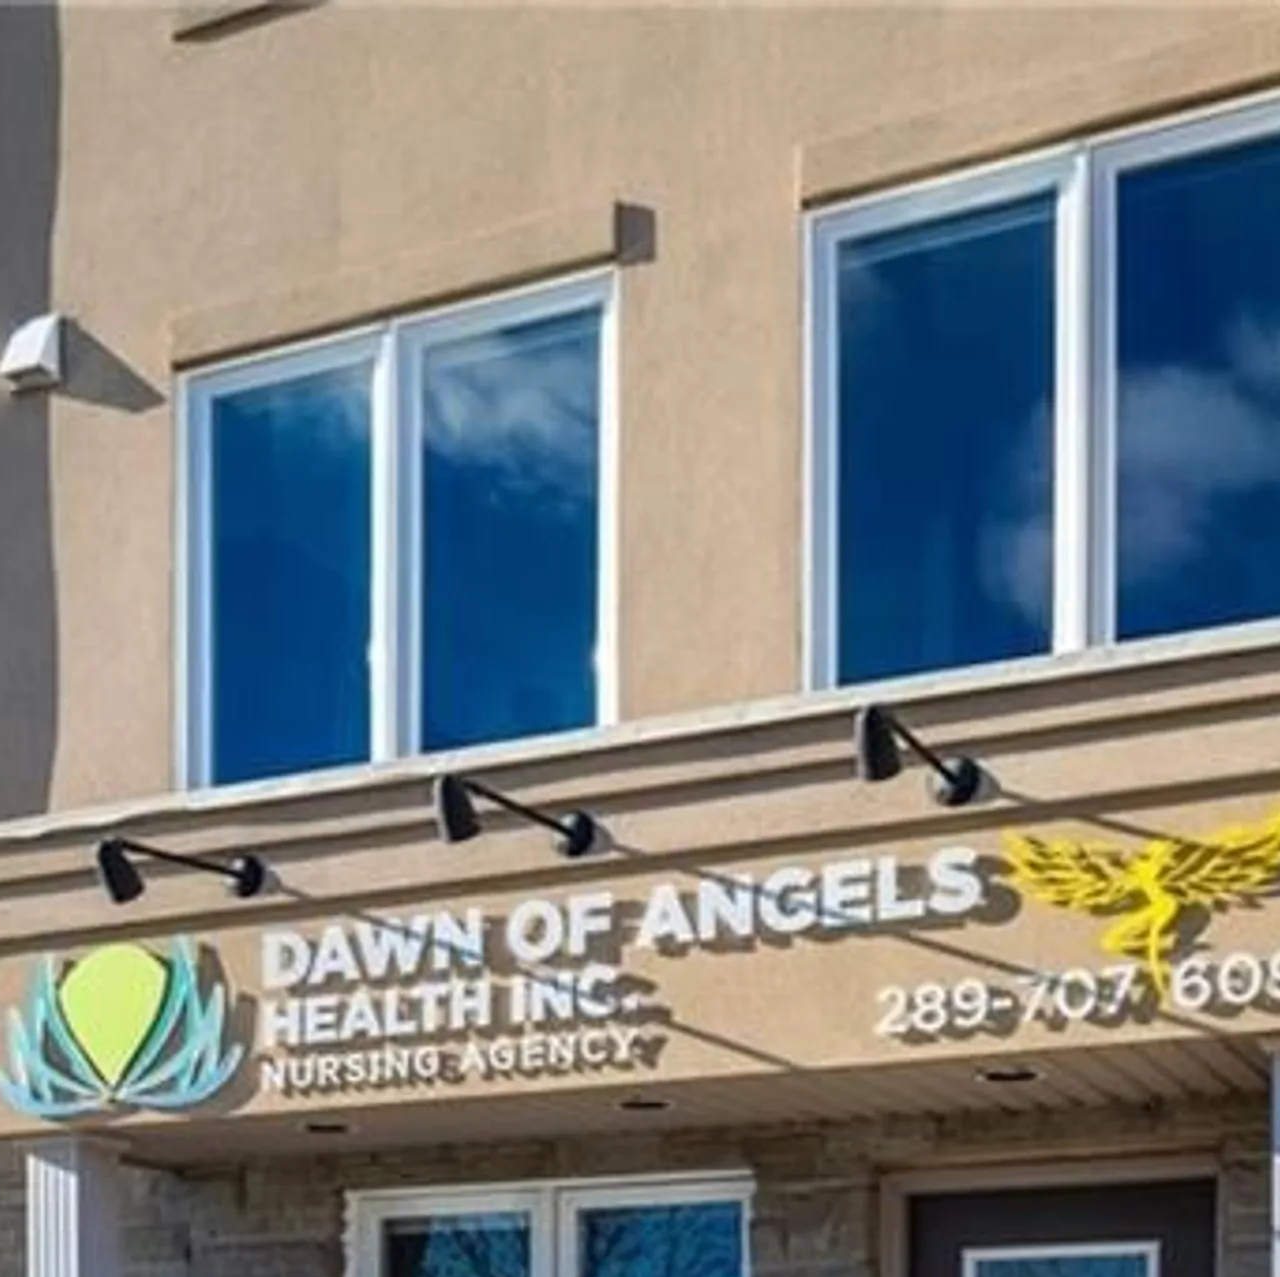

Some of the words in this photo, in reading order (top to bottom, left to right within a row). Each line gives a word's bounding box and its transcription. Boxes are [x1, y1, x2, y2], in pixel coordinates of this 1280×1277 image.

[260, 907, 483, 989] DAWN
[506, 890, 613, 964] OF
[635, 846, 983, 948] ANGELS
[261, 976, 491, 1050] HEALTH
[510, 962, 639, 1024] INC.
[259, 1047, 457, 1092] NURSING
[460, 1027, 639, 1078] AGENCY
